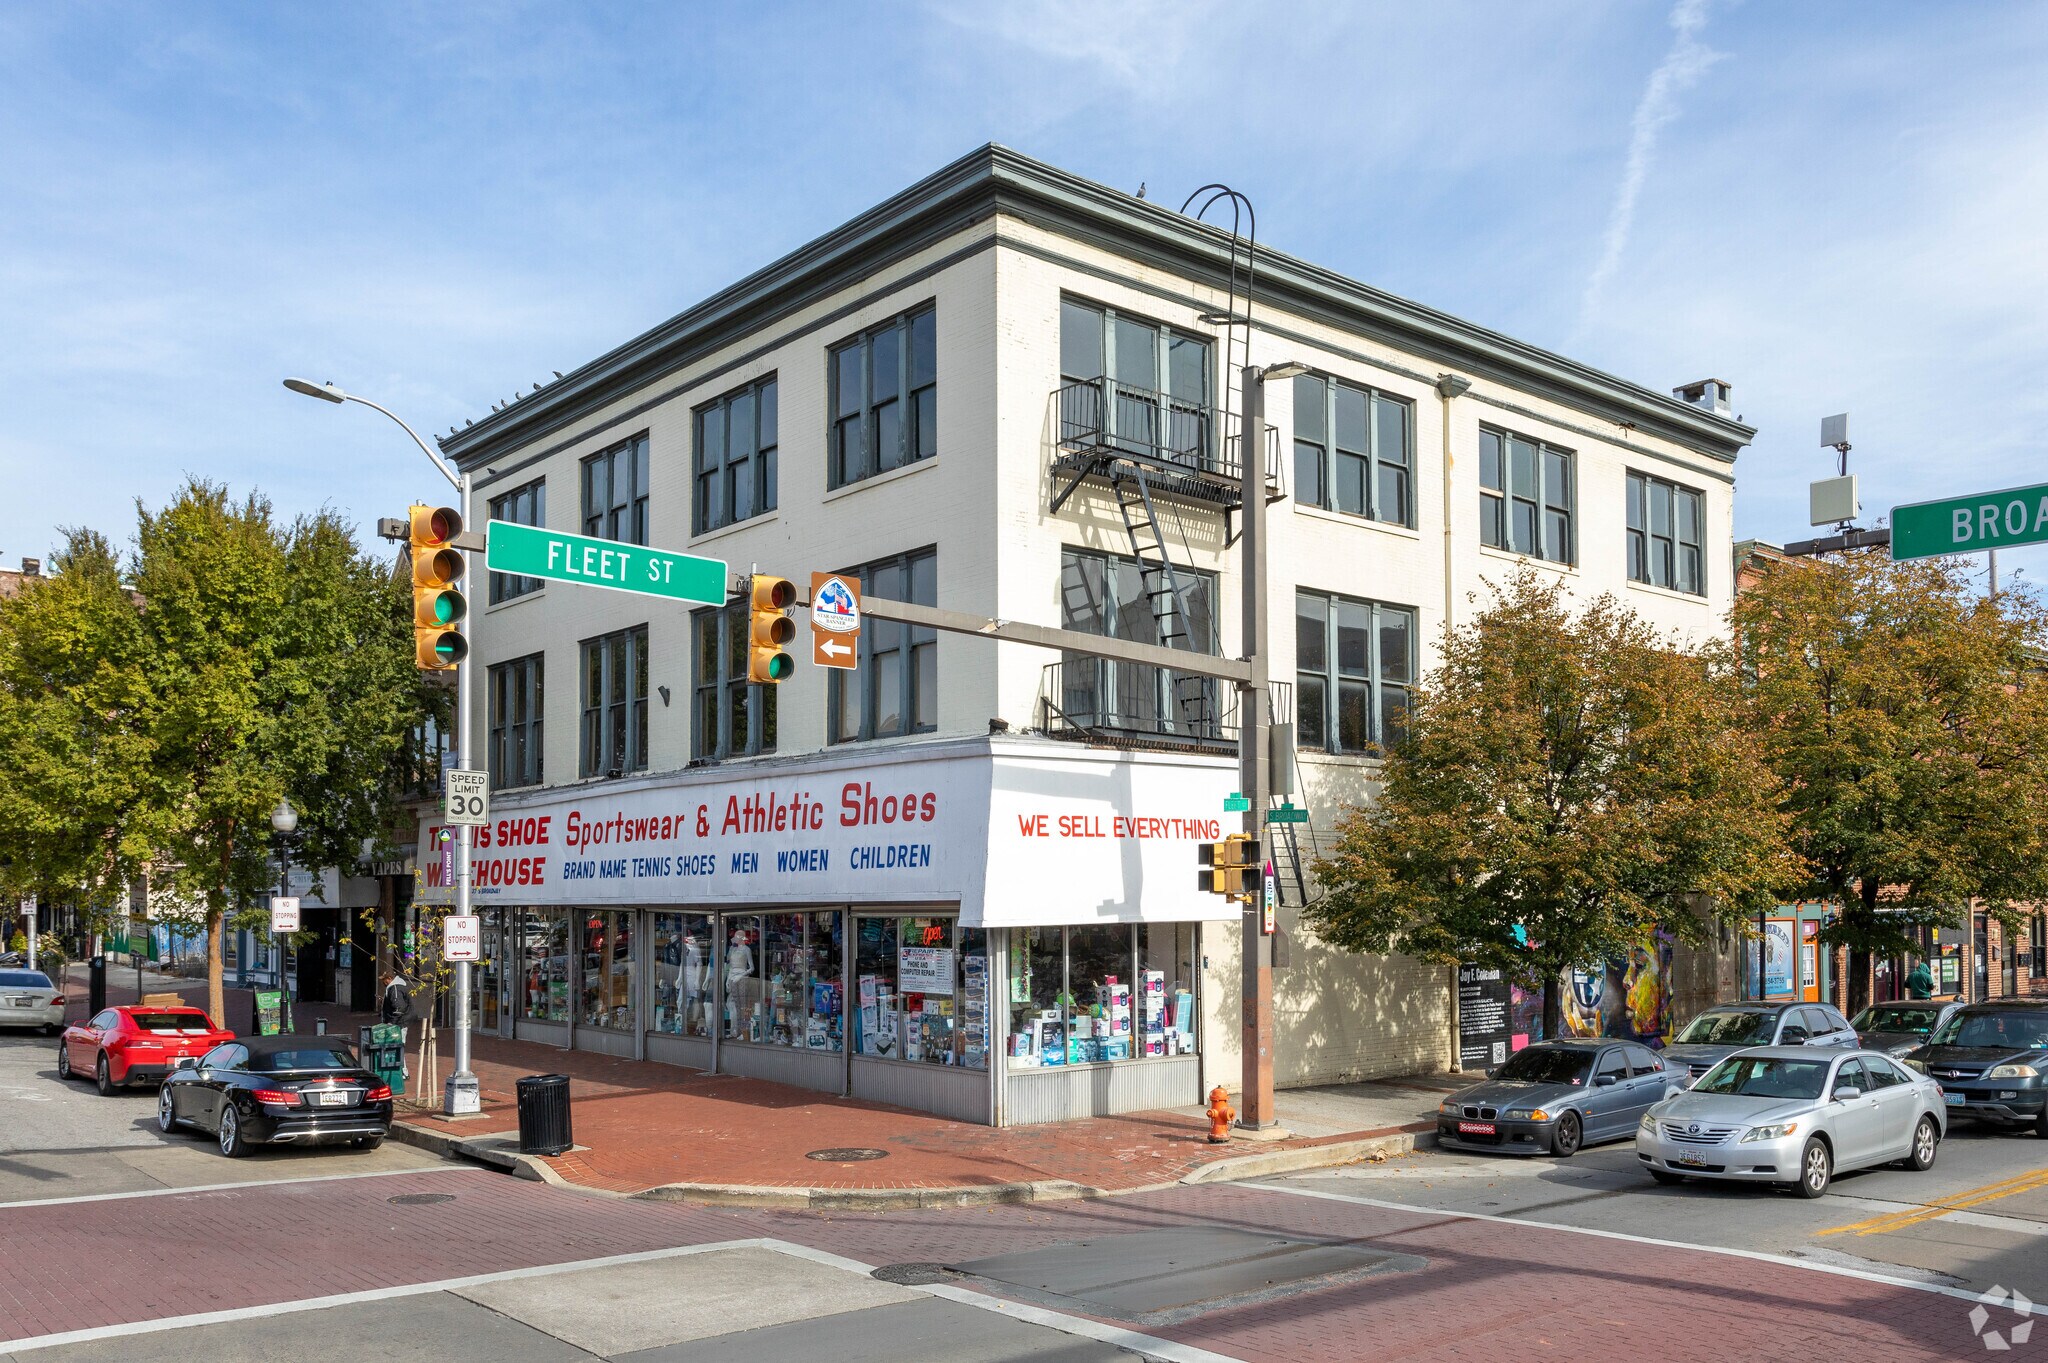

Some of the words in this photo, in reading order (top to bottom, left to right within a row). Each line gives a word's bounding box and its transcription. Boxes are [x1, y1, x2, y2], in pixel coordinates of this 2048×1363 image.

[1952, 496, 2048, 543] BROA
[548, 541, 631, 582] FLEET
[648, 558, 674, 584] ST
[451, 774, 486, 785] SPEED
[454, 785, 481, 795] LIMIT
[450, 795, 484, 816] 30
[1225, 800, 1241, 810] FLEET
[566, 810, 685, 855] Sportswear
[696, 804, 711, 838] &
[721, 791, 824, 836] Athletic
[840, 781, 936, 828] Shoes
[1269, 812, 1273, 820] S
[1275, 811, 1308, 820] BROADWAY
[497, 816, 552, 847] SHOE
[1018, 814, 1050, 837] WE
[1058, 815, 1106, 838] SELL
[1113, 816, 1220, 840] EVERYTHING
[372, 861, 402, 876] VAPES
[563, 861, 596, 880] BRAND
[599, 859, 627, 878] NAME
[632, 856, 671, 878] TENNIS
[676, 854, 716, 876] SHOES
[731, 852, 759, 874] MEN
[777, 849, 829, 873] WOMEN
[850, 844, 931, 870] CHILDREN
[457, 920, 467, 929] NO
[588, 919, 603, 929] OPEN
[448, 935, 476, 944] STOPPING
[907, 960, 920, 968] PHONE
[920, 961, 929, 969] AND
[901, 968, 920, 976] COMPUTER
[921, 969, 936, 977] REPAIR
[1460, 968, 1470, 983] Jay
